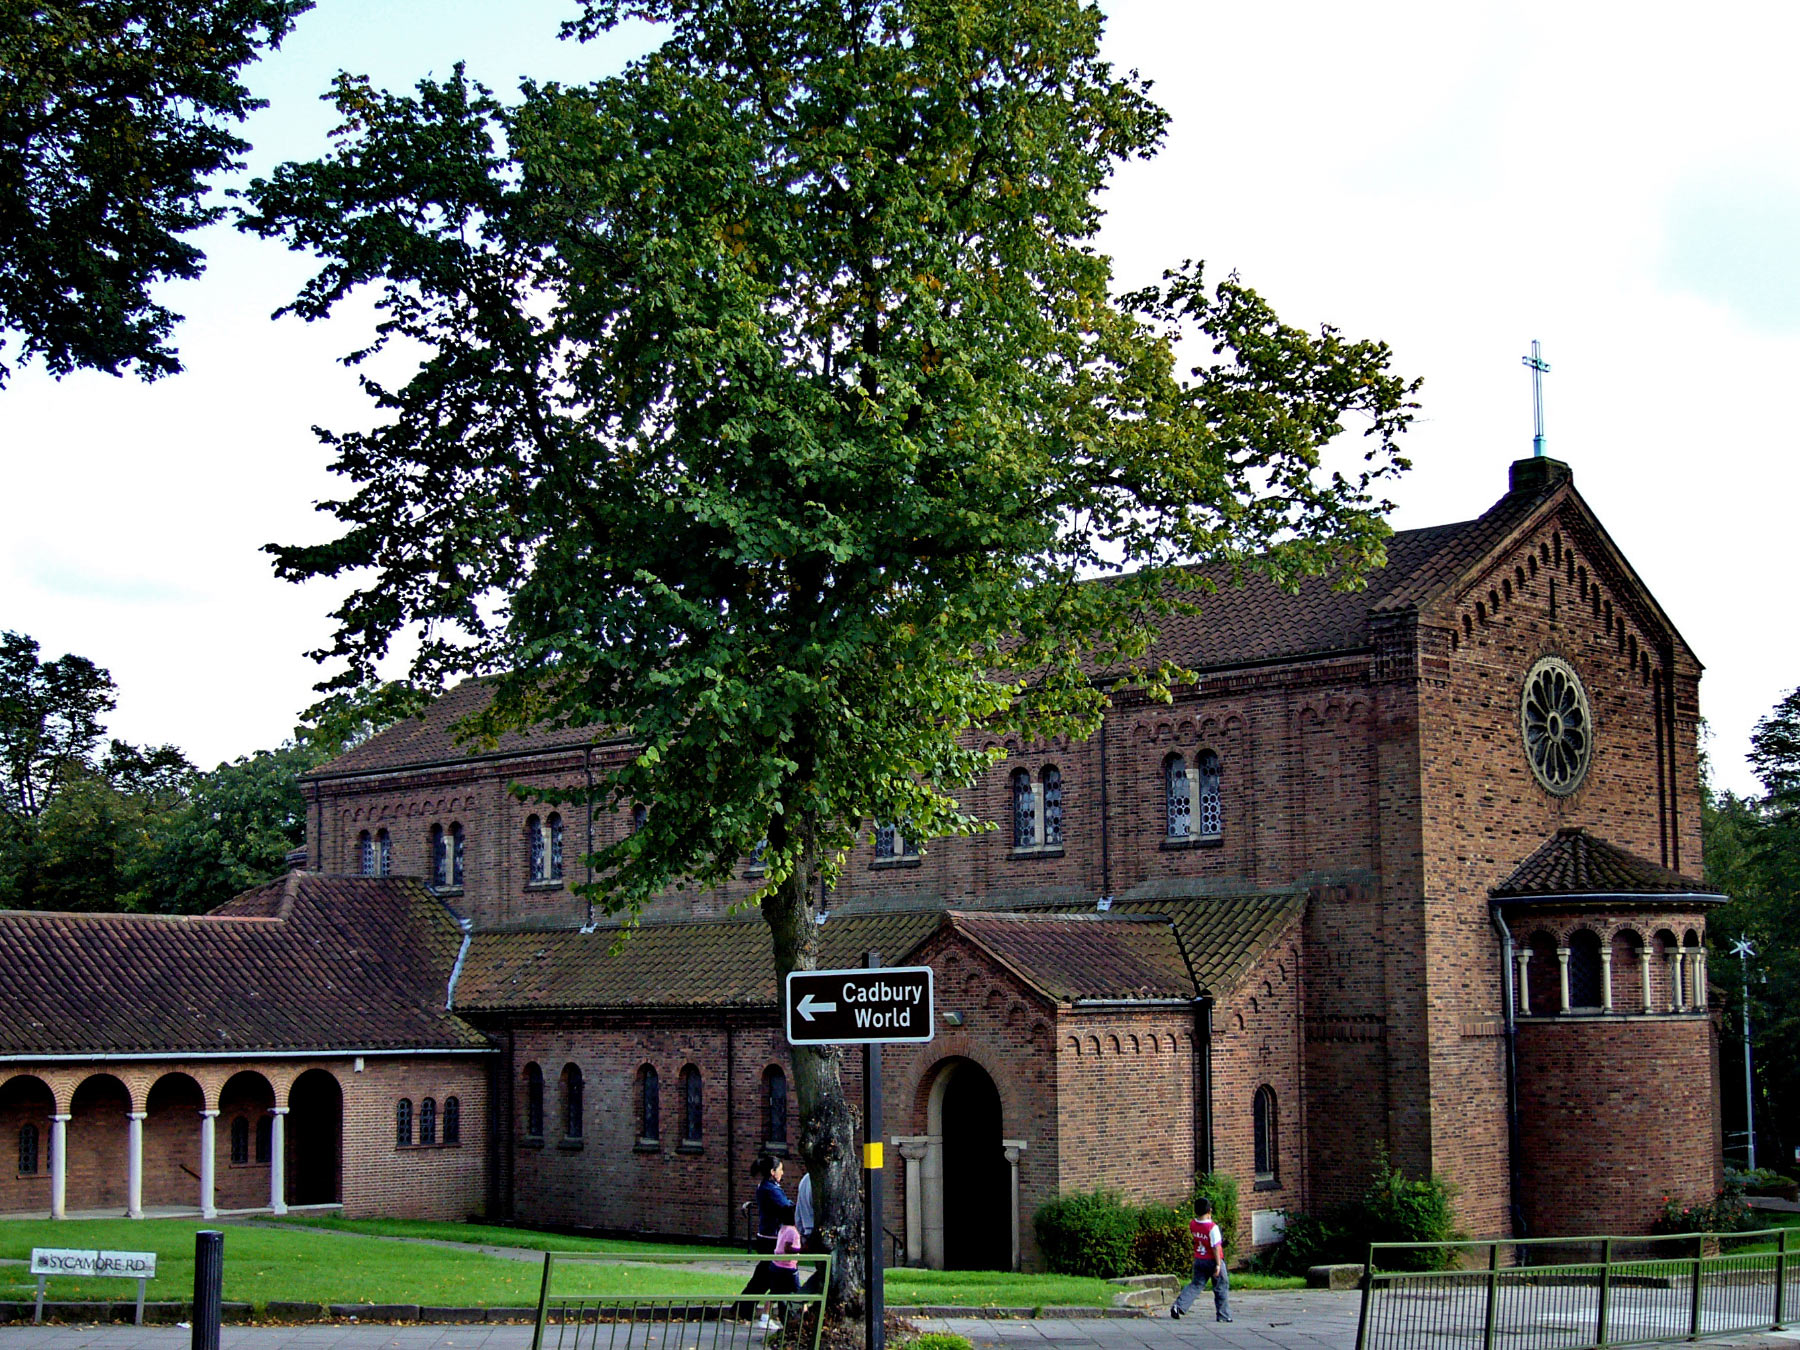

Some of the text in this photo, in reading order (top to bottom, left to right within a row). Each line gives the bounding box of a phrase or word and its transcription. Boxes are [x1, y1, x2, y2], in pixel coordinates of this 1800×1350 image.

[842, 982, 922, 1004] Cadbury
[855, 1007, 911, 1028] World
[49, 1256, 146, 1272] SYCAMORE RD
